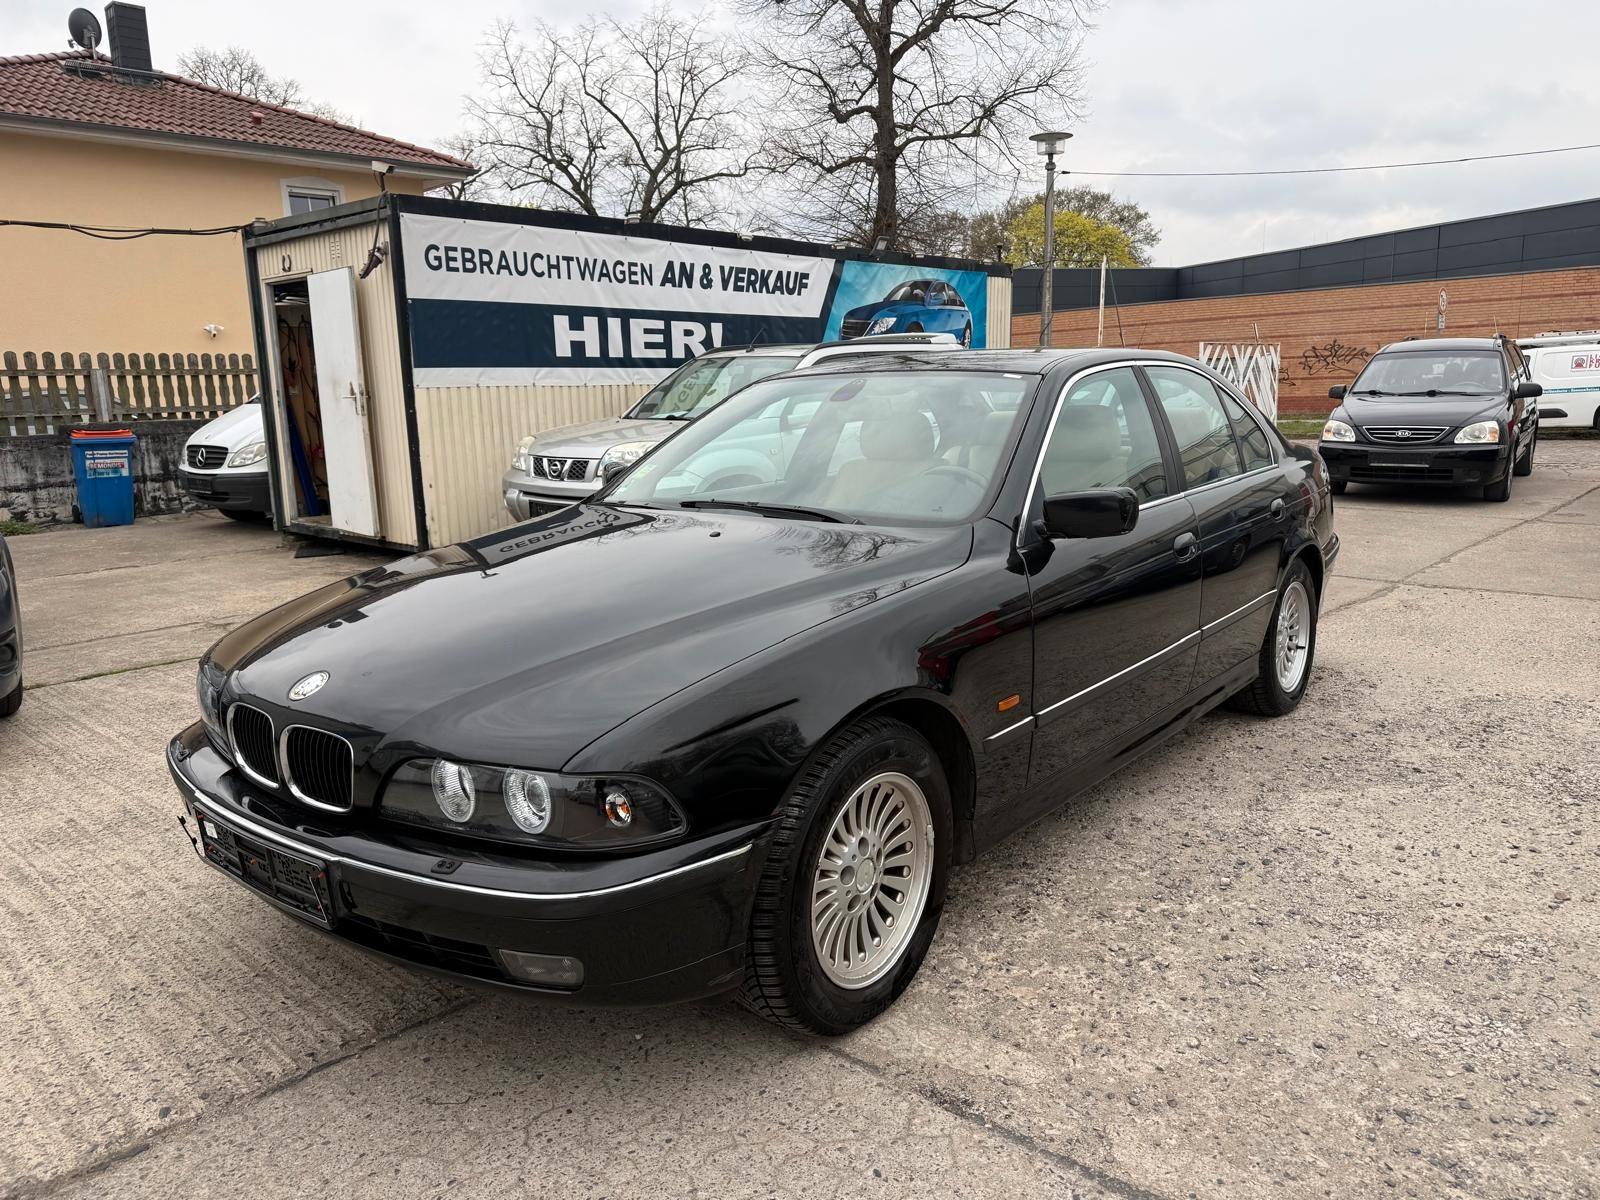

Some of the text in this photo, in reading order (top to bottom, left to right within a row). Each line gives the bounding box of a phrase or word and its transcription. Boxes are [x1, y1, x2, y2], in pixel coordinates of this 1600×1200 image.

[424, 244, 810, 297] GEBRAUCHTWAGEN AN & VERKAUF
